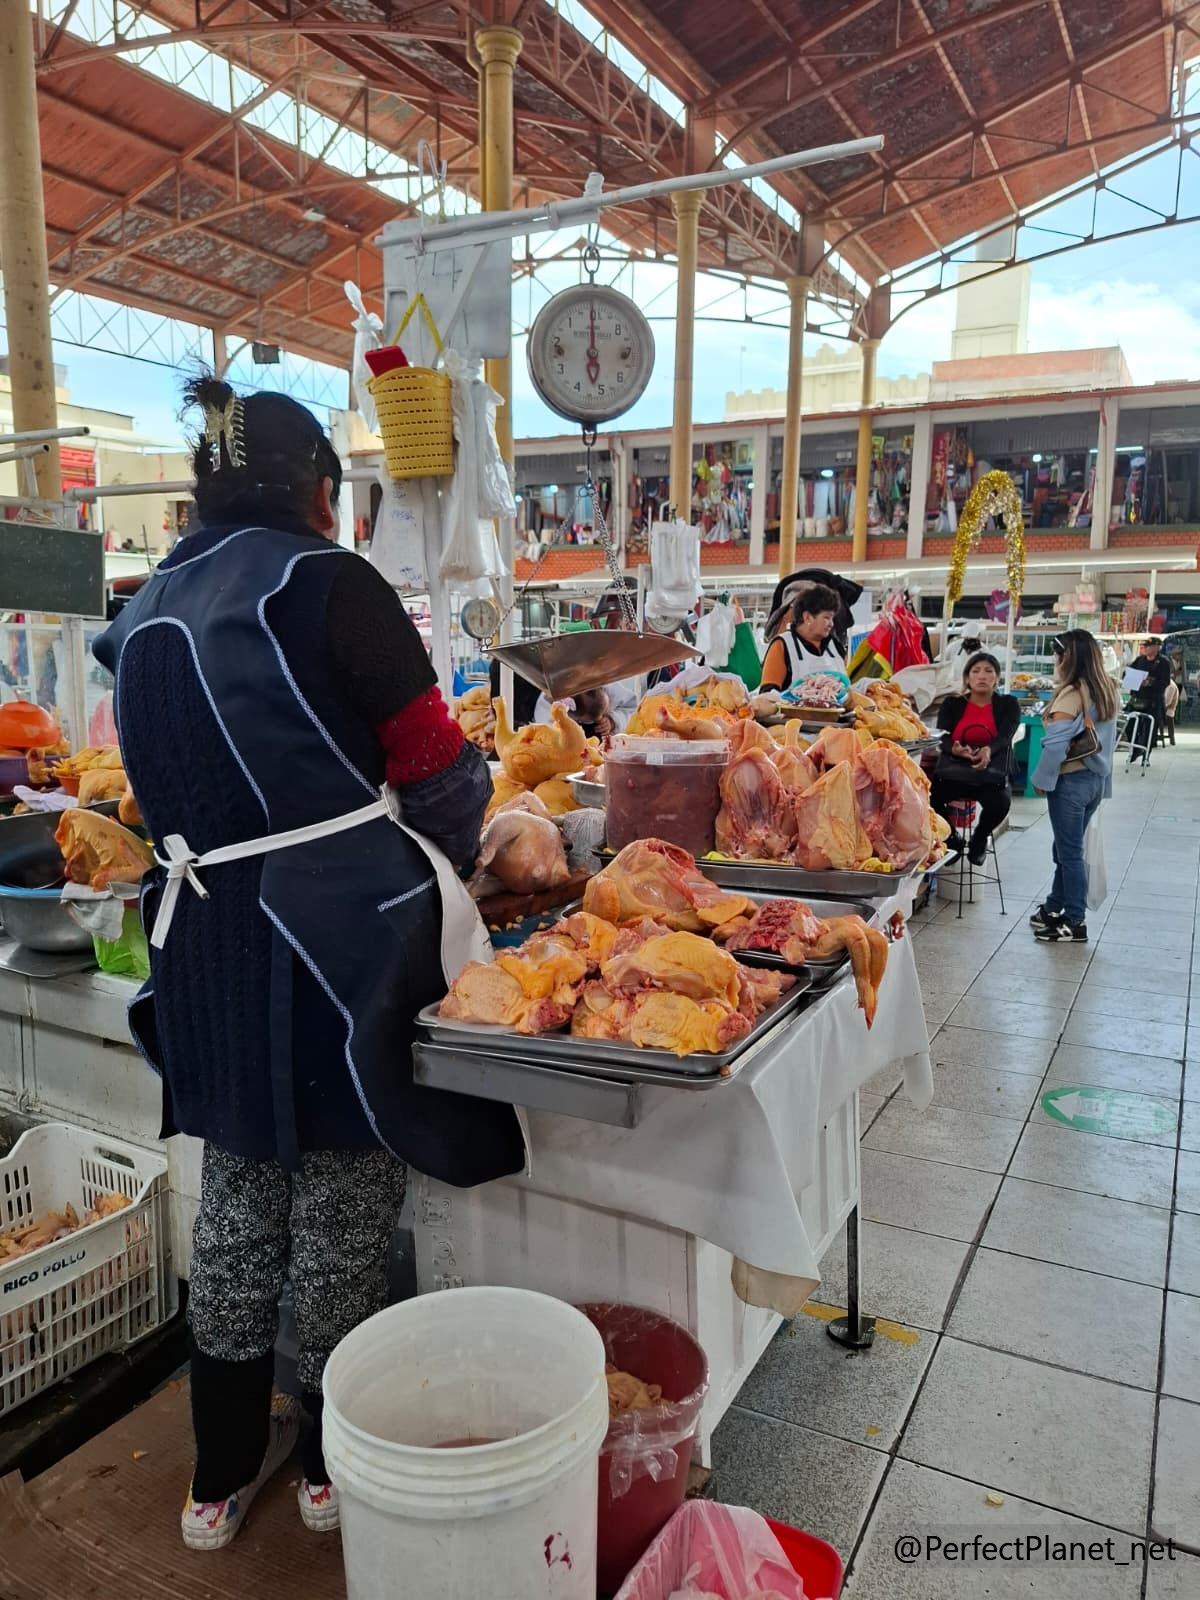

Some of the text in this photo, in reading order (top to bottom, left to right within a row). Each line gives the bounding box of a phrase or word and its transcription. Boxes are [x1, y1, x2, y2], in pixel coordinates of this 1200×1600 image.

[614, 324, 622, 336] 8
[553, 337, 561, 348] 2
[557, 364, 564, 375] 3
[616, 372, 624, 383] 6
[573, 382, 581, 393] 4
[598, 385, 605, 396] 5
[3, 1249, 86, 1294] RICO POLLO
